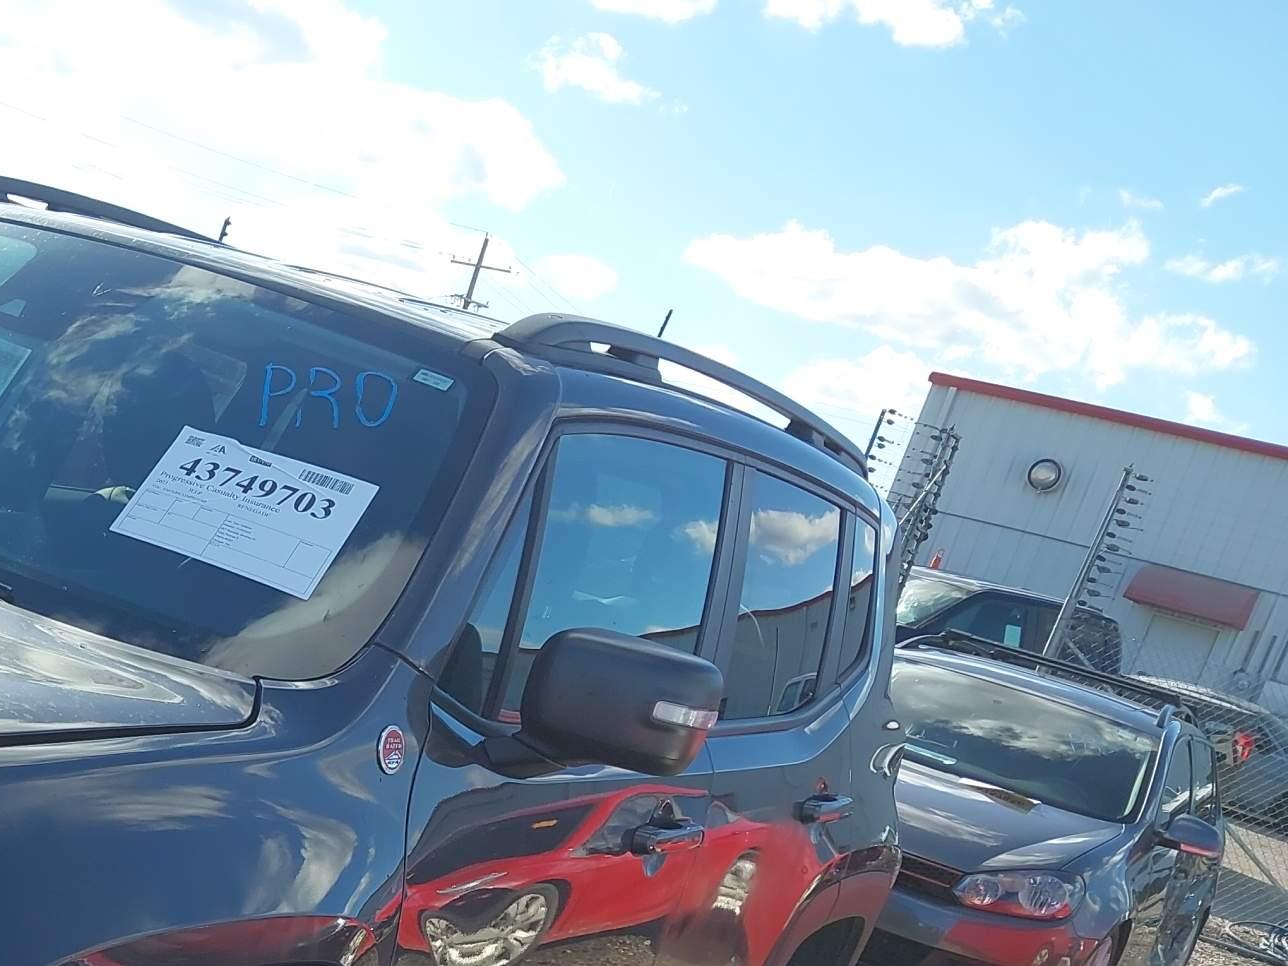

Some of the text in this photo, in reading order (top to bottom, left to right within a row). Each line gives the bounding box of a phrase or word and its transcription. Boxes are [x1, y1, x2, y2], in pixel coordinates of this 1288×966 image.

[259, 362, 398, 428] PRO
[160, 471, 203, 489] Progressive
[206, 484, 239, 500] Casualty
[242, 496, 281, 513] Insurance
[179, 458, 336, 519] 43749703
